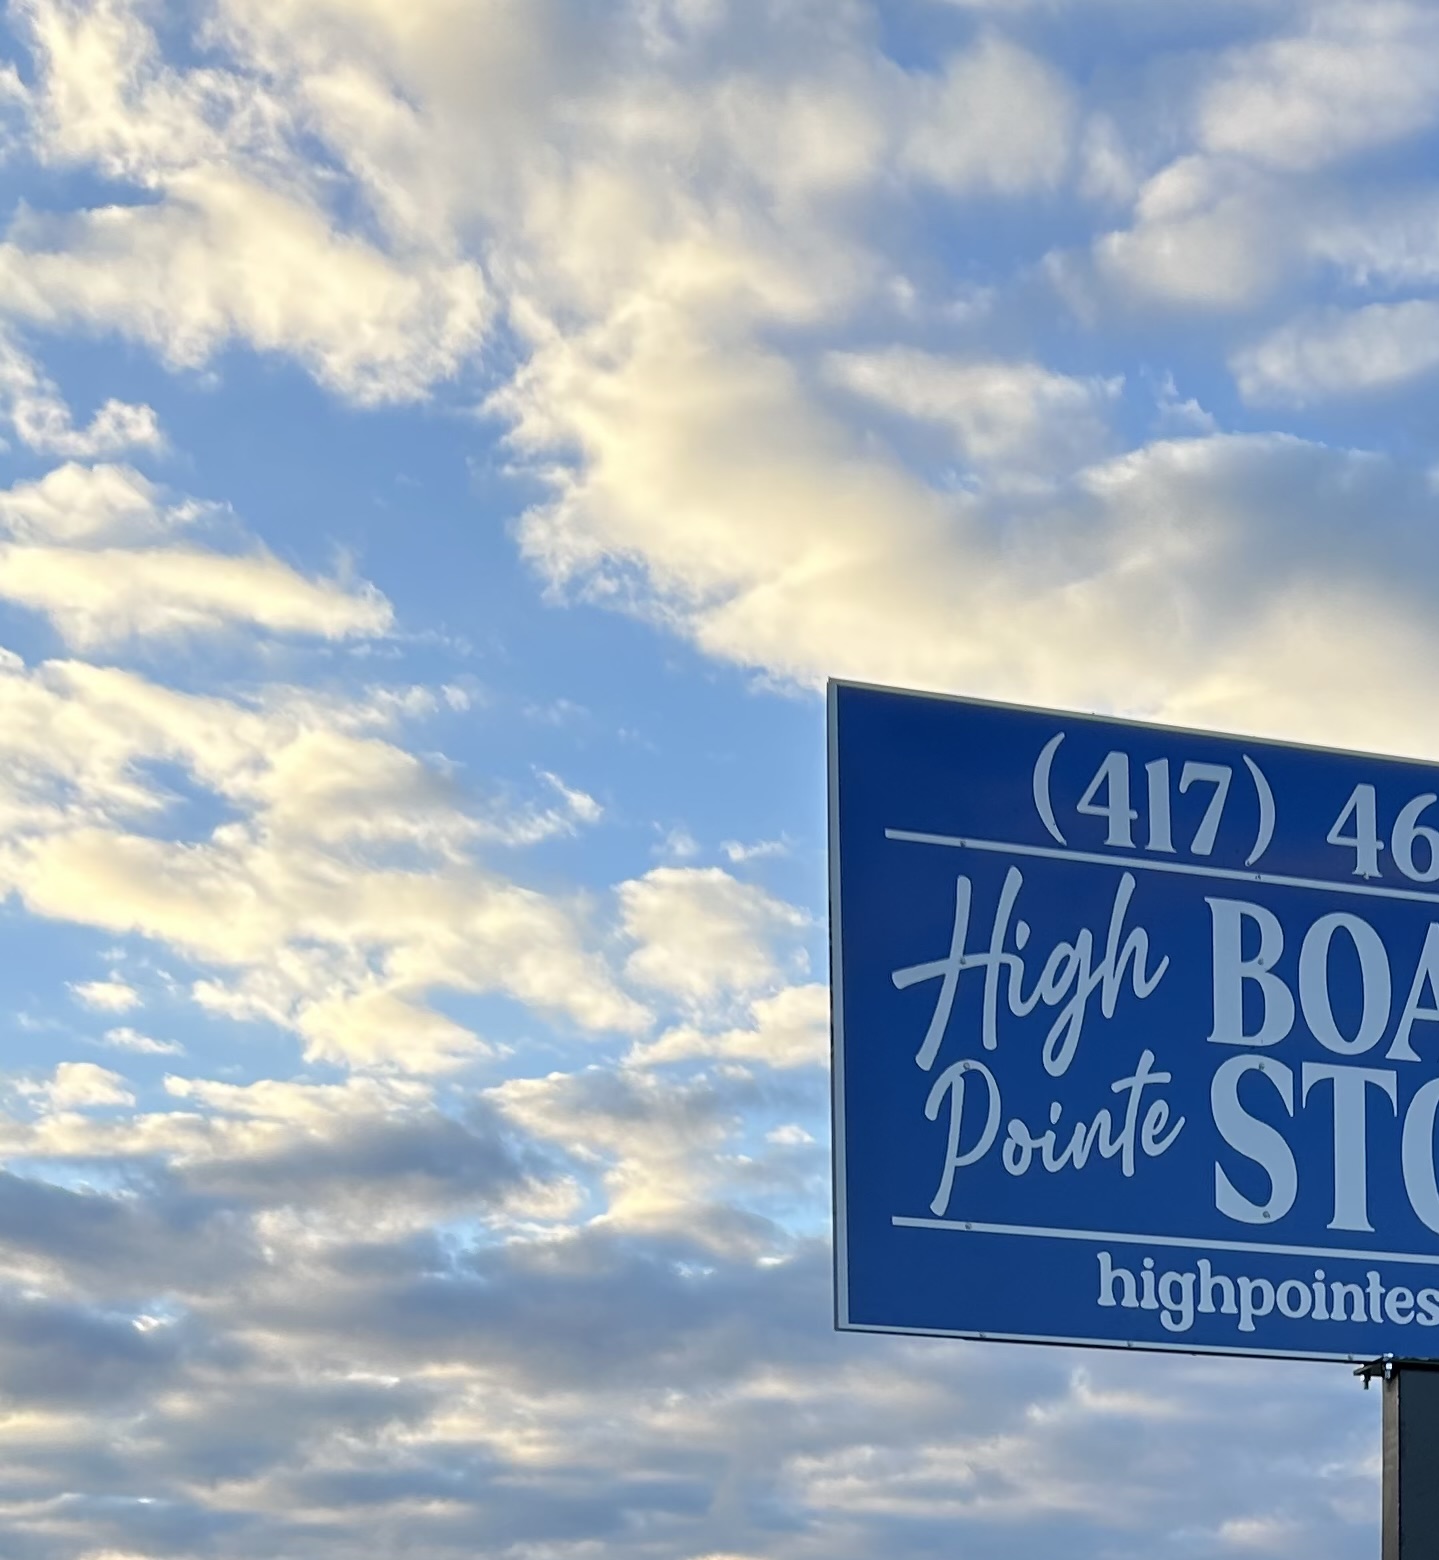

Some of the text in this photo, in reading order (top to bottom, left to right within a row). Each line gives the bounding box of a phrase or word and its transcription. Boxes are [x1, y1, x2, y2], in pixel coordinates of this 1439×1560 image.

[1034, 733, 1276, 866] (417)
[892, 866, 1169, 1076] High
[925, 1050, 1186, 1217] Pointe
